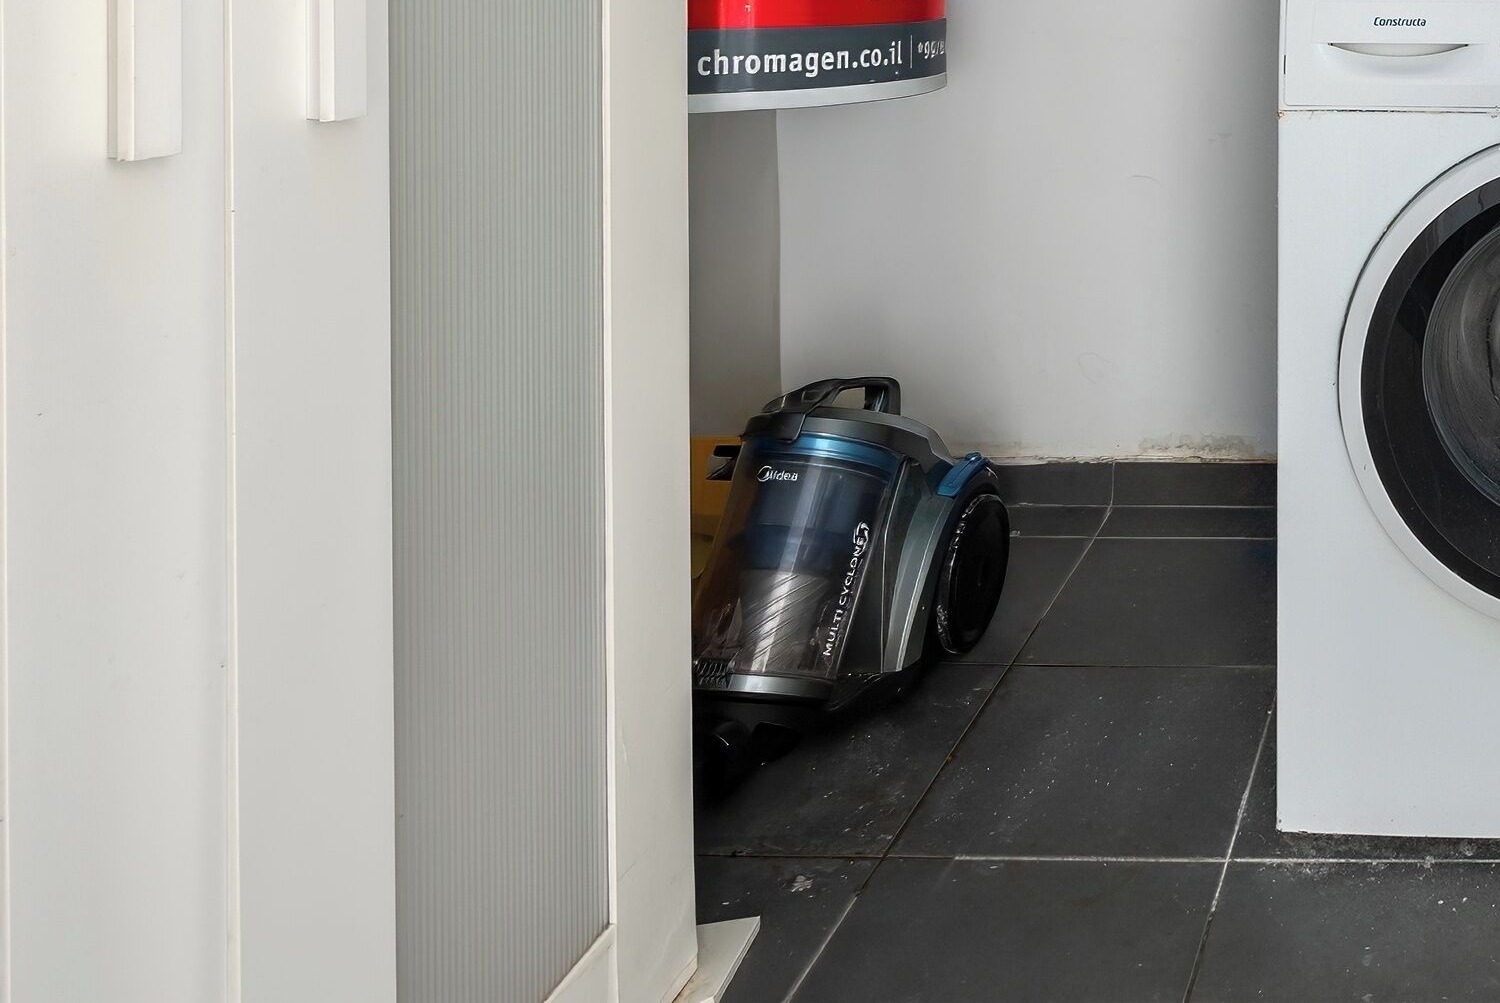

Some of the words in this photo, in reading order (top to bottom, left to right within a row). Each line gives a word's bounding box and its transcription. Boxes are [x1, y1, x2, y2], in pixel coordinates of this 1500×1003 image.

[1373, 17, 1427, 26] Constructa
[697, 40, 902, 78] chromagen.co.il
[757, 465, 798, 482] Midea
[823, 609, 844, 656] MULTI
